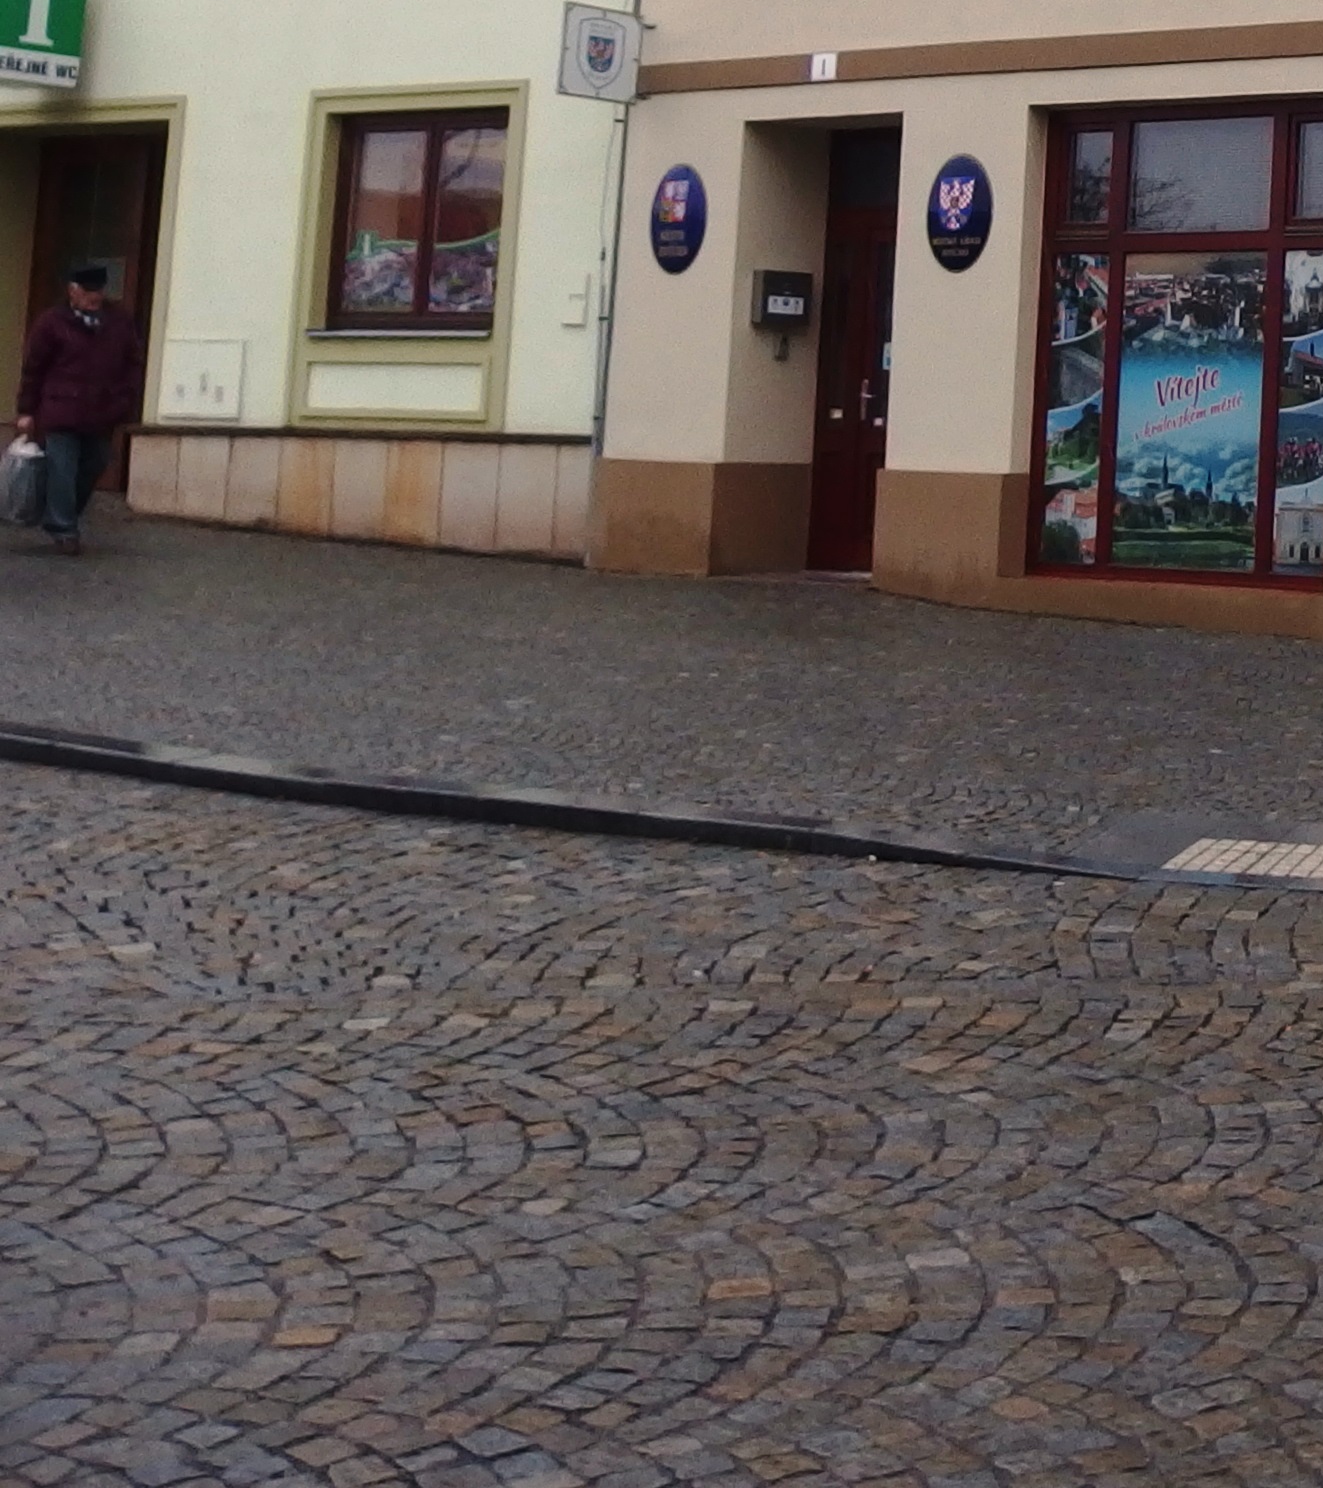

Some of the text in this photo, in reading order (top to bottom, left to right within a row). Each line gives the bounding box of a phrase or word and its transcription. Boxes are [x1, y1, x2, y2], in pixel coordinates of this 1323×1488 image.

[0, 54, 78, 79] EŘEJNÉ WC
[1156, 366, 1219, 408] Vítejte
